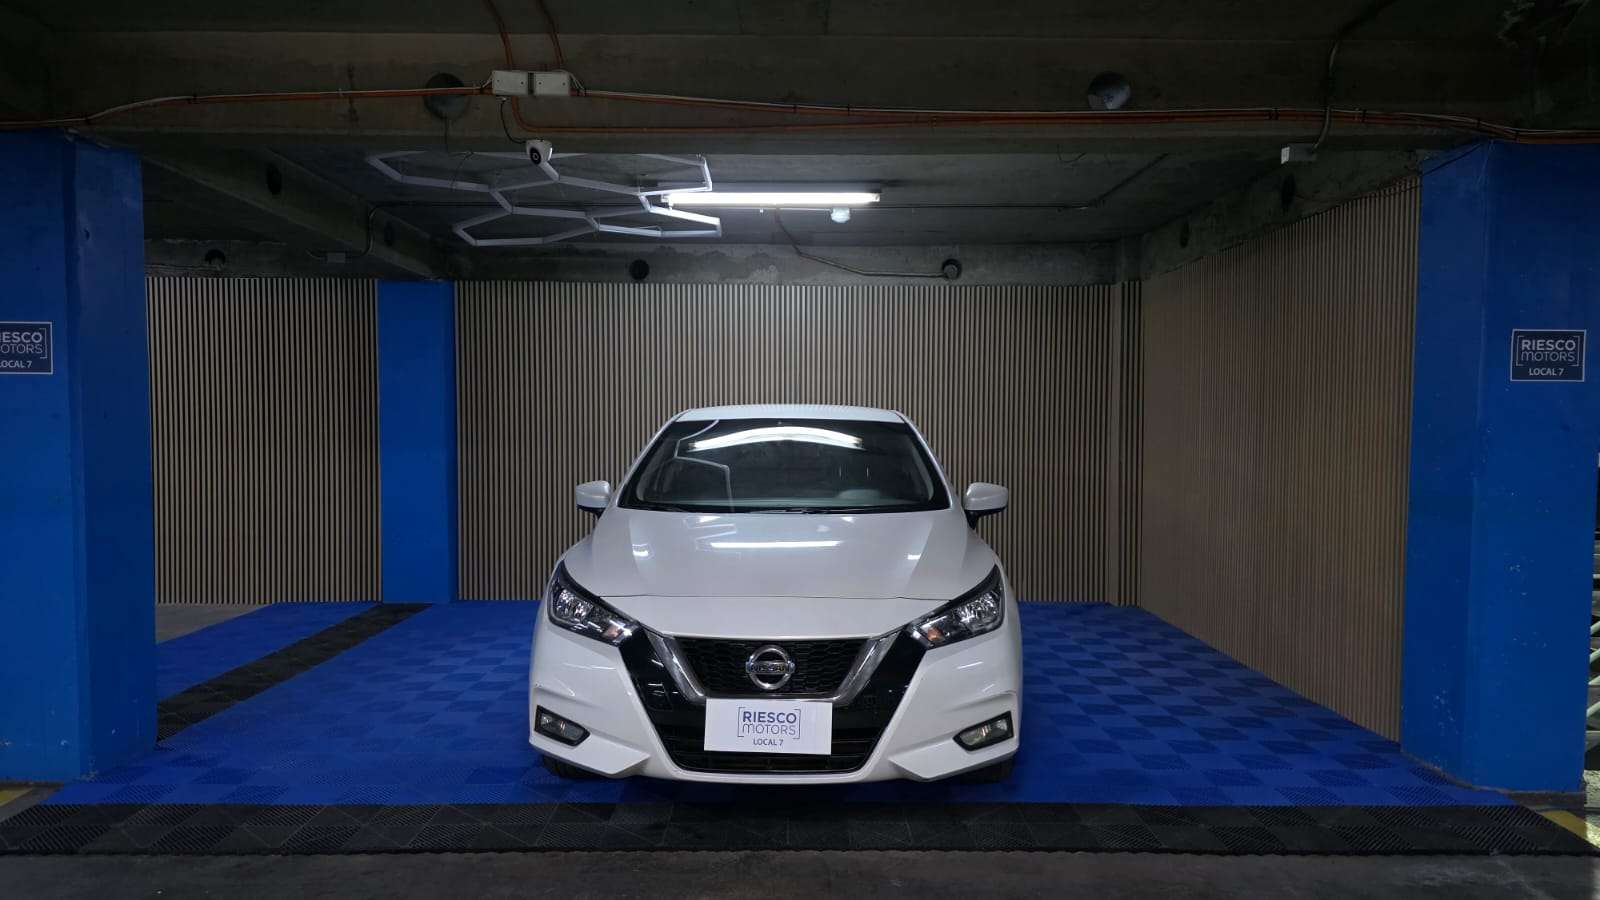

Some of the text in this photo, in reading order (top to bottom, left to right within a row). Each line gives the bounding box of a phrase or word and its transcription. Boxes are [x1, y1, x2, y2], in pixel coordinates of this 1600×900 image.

[0, 331, 43, 343] ESCO
[0, 343, 43, 354] OTORS
[1521, 339, 1576, 351] RIESCO
[1521, 351, 1576, 362] MOTORS
[0, 360, 33, 368] OCAL 7
[1529, 367, 1564, 376] LOCAL 7
[742, 711, 797, 724] RIESCO
[742, 723, 796, 735] MOTORS
[753, 738, 778, 746] LOCAL
